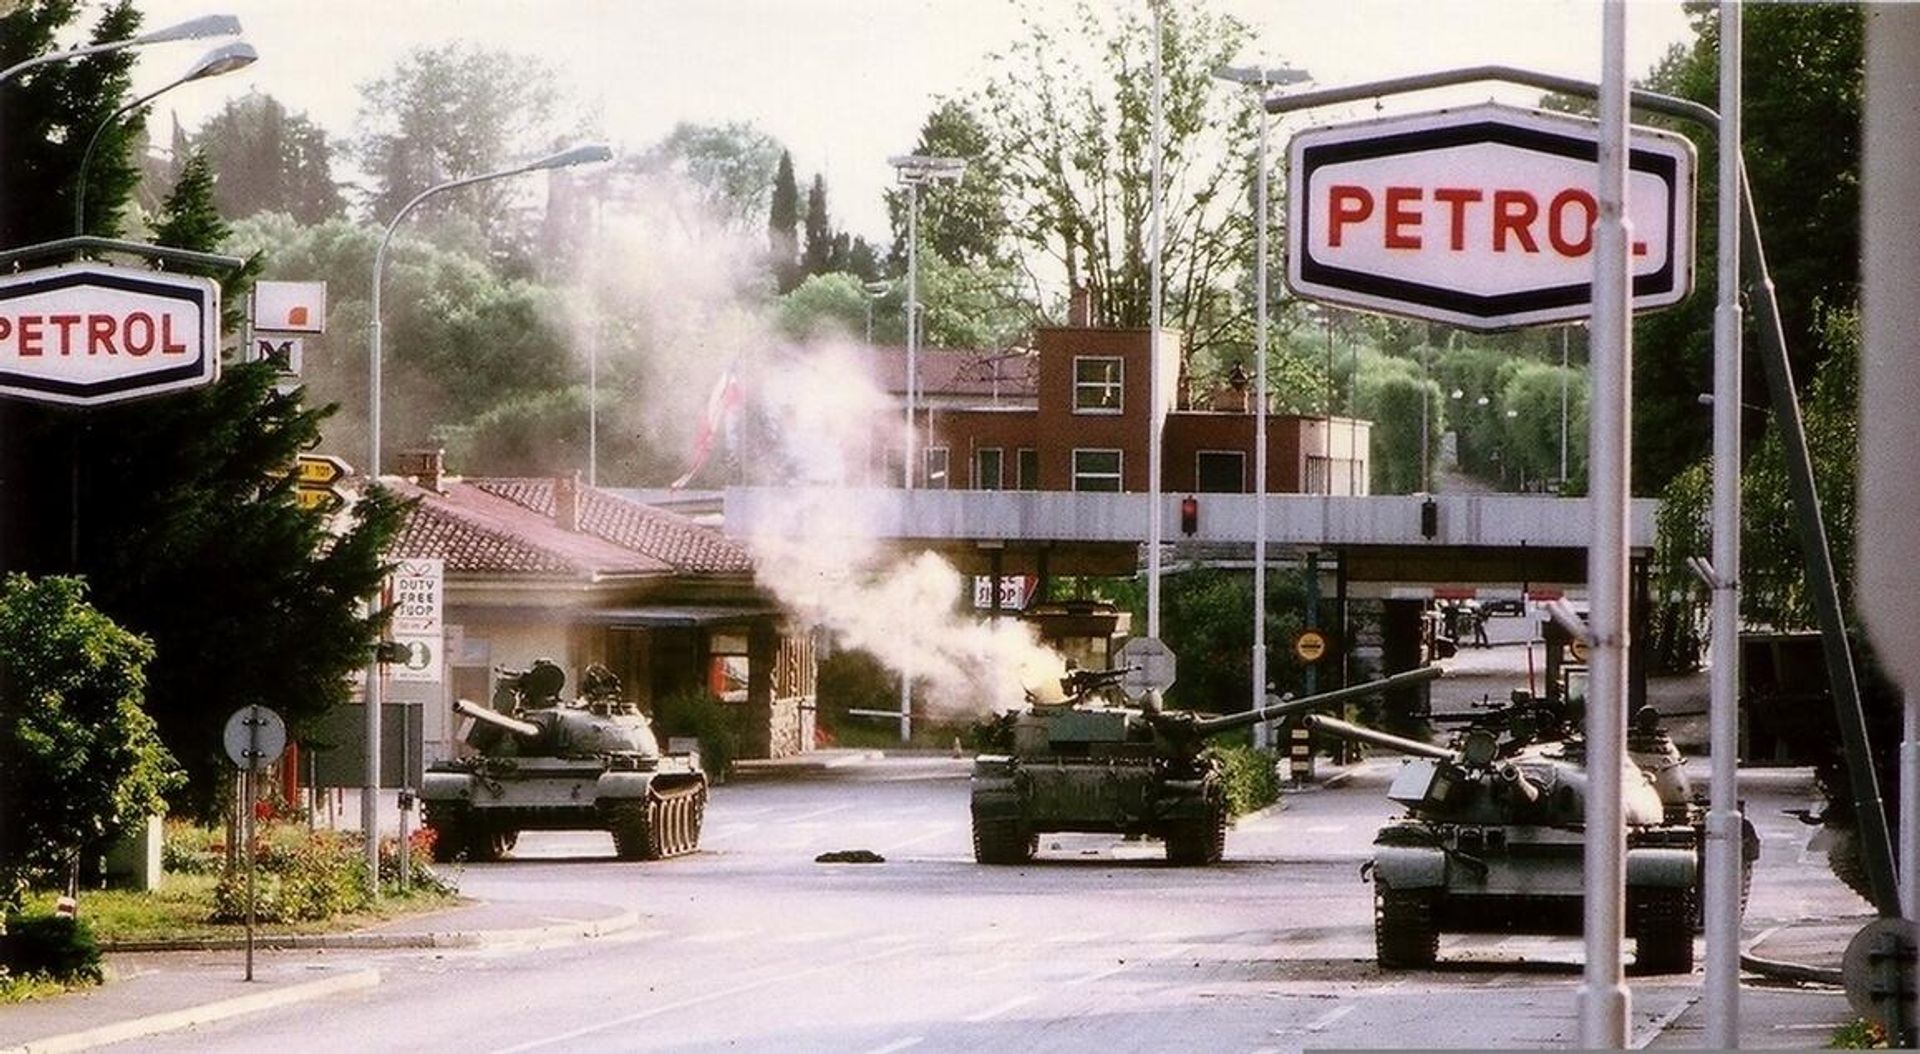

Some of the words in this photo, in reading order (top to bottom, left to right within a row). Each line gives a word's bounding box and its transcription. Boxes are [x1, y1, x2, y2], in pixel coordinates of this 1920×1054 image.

[1327, 185, 1647, 258] PETRO
[400, 579, 434, 590] DUTY
[400, 592, 434, 603] FREE
